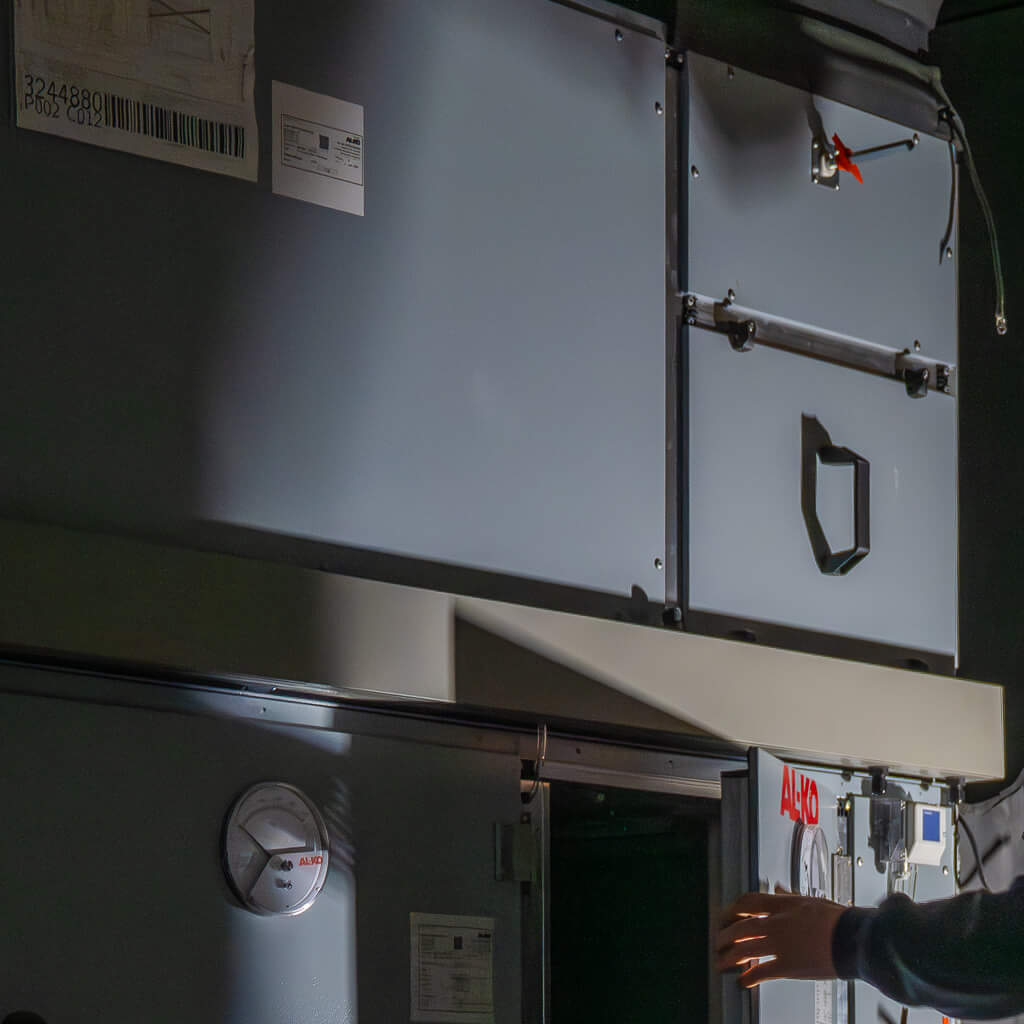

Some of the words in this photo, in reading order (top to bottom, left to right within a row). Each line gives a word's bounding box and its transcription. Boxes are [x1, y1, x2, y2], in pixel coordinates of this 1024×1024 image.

[25, 74, 102, 113] 3244880
[25, 95, 60, 118] P002
[67, 105, 103, 128] C012
[780, 765, 819, 825] AL-KO
